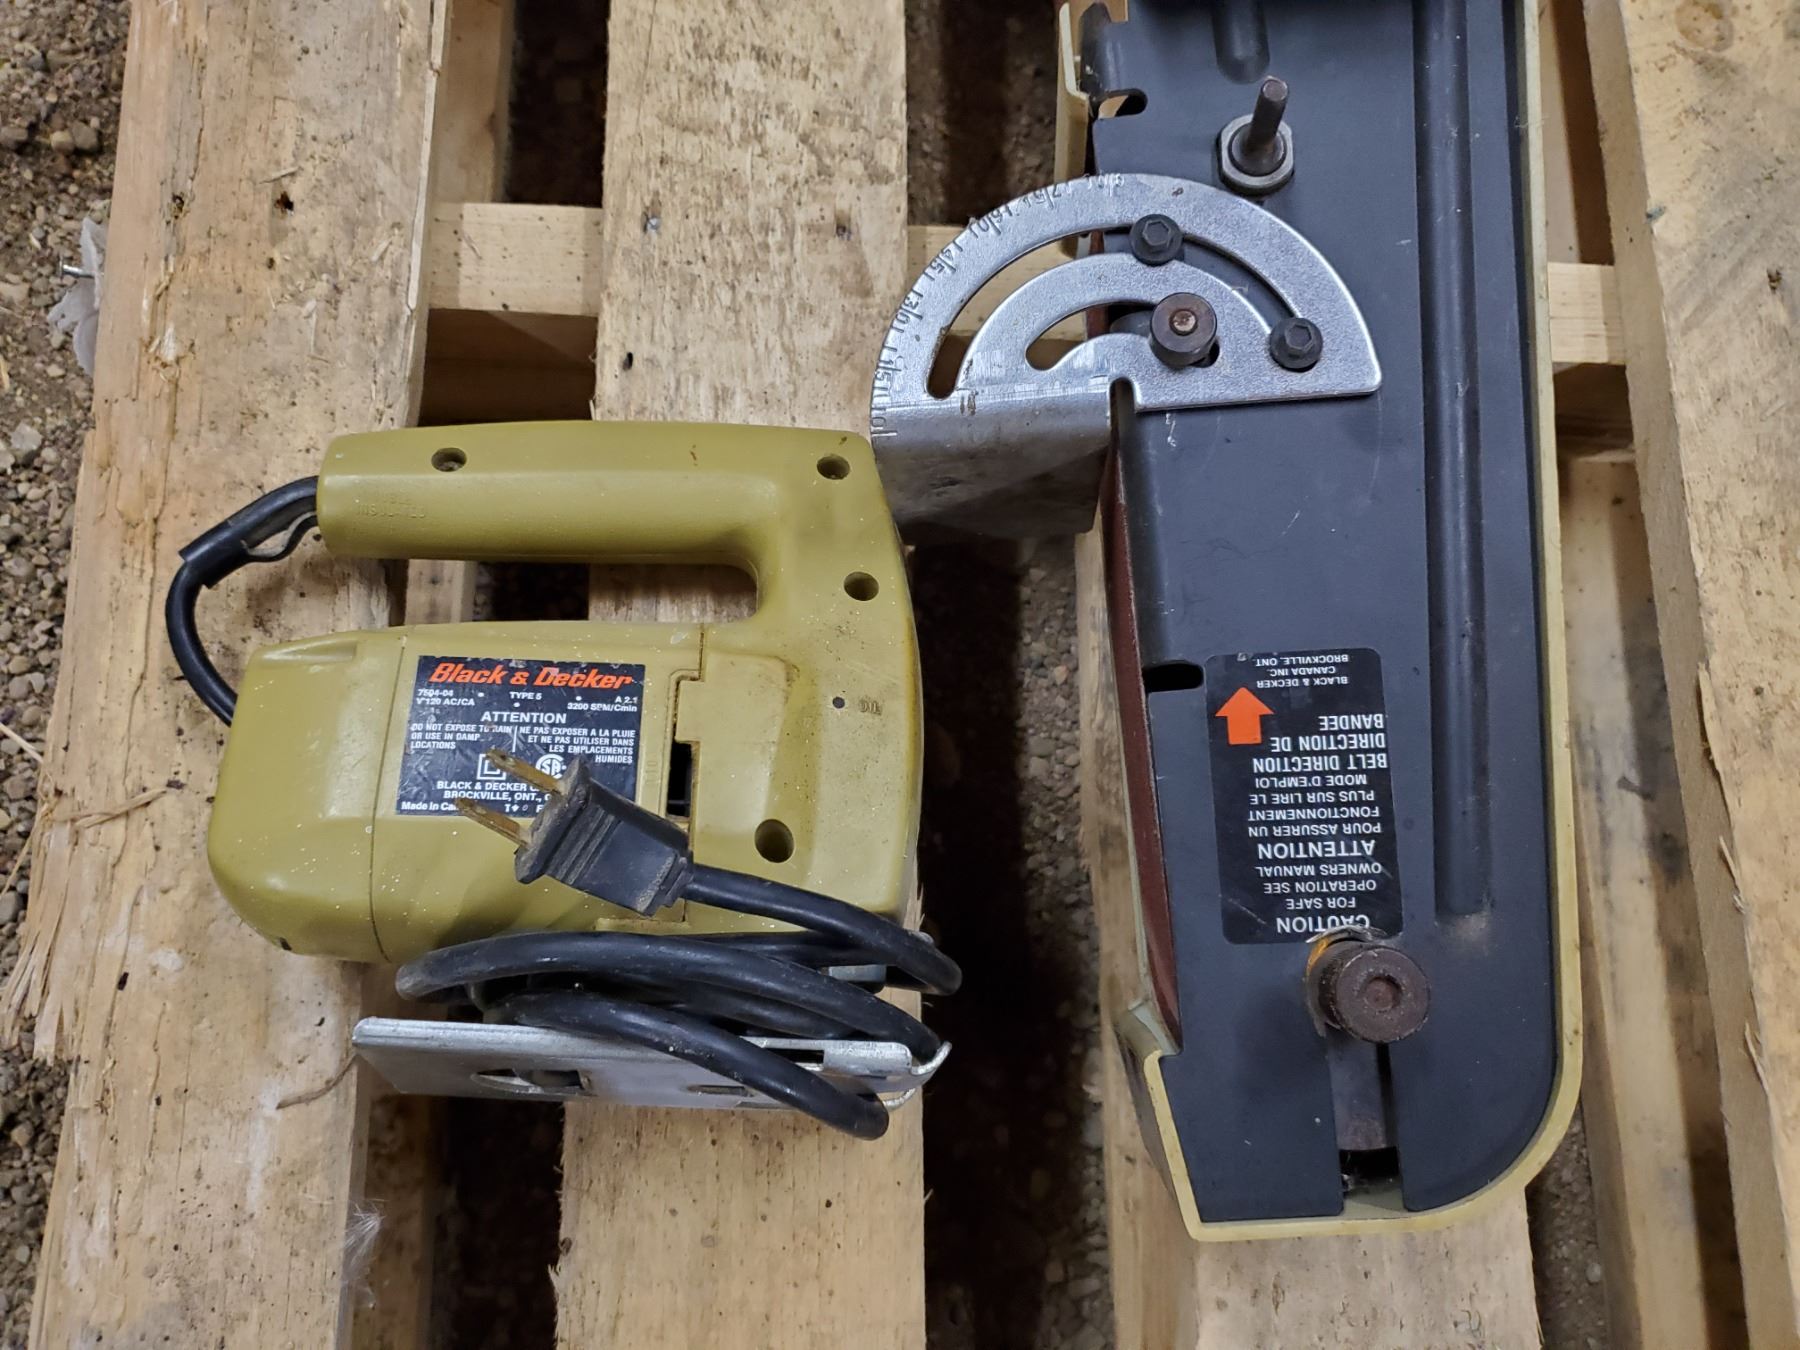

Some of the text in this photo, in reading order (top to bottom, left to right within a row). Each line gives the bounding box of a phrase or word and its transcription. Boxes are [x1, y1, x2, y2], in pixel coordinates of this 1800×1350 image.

[1253, 657, 1278, 666] ONT.
[428, 662, 633, 689] Black & Decker
[1266, 666, 1336, 677] CANADA INC.
[1256, 676, 1348, 688] BLACK & DECKER
[418, 688, 454, 697] 7504-04
[509, 691, 543, 700] TYPE 5
[443, 698, 476, 706] AC/CA
[614, 696, 622, 704] A
[567, 702, 638, 712] 3200 SPM/Cmin
[480, 711, 567, 725] ATTENTION
[1318, 714, 1384, 731] BANDEE
[426, 724, 442, 732] NOT
[445, 724, 476, 732] EXPOSE
[519, 726, 636, 738] NE PAS EXPOSER A LA PLUIE
[411, 732, 480, 742] OR USE IN DAMP
[528, 735, 634, 747] ET NE PAS UTILISER DANS
[1270, 733, 1386, 752] DIRECTION DE
[410, 741, 456, 750] LOCATIONS
[549, 744, 634, 755] LES EMPLACEMENTS
[595, 754, 633, 764] HUMIDES
[1253, 753, 1388, 773] BELT DIRECTION
[436, 781, 472, 790] BLACK
[474, 782, 482, 790] &
[485, 782, 527, 792] DECKER
[1255, 774, 1367, 789] MODE D'EMPLOI
[444, 790, 512, 802] BROCKVILLE,
[1250, 790, 1375, 805] PLUS SUR LIRE LE
[401, 802, 428, 810] Made
[1248, 806, 1380, 822] FONCTIONNEMENT
[1248, 822, 1382, 838] POUR ASSURER UN
[1257, 839, 1376, 860] ATTENTION
[1255, 862, 1383, 878] OWNERS MANUAL
[1263, 879, 1377, 894] OPERATION SEE
[1286, 897, 1356, 910] FOR SAFE
[1276, 914, 1371, 933] CAUTION
